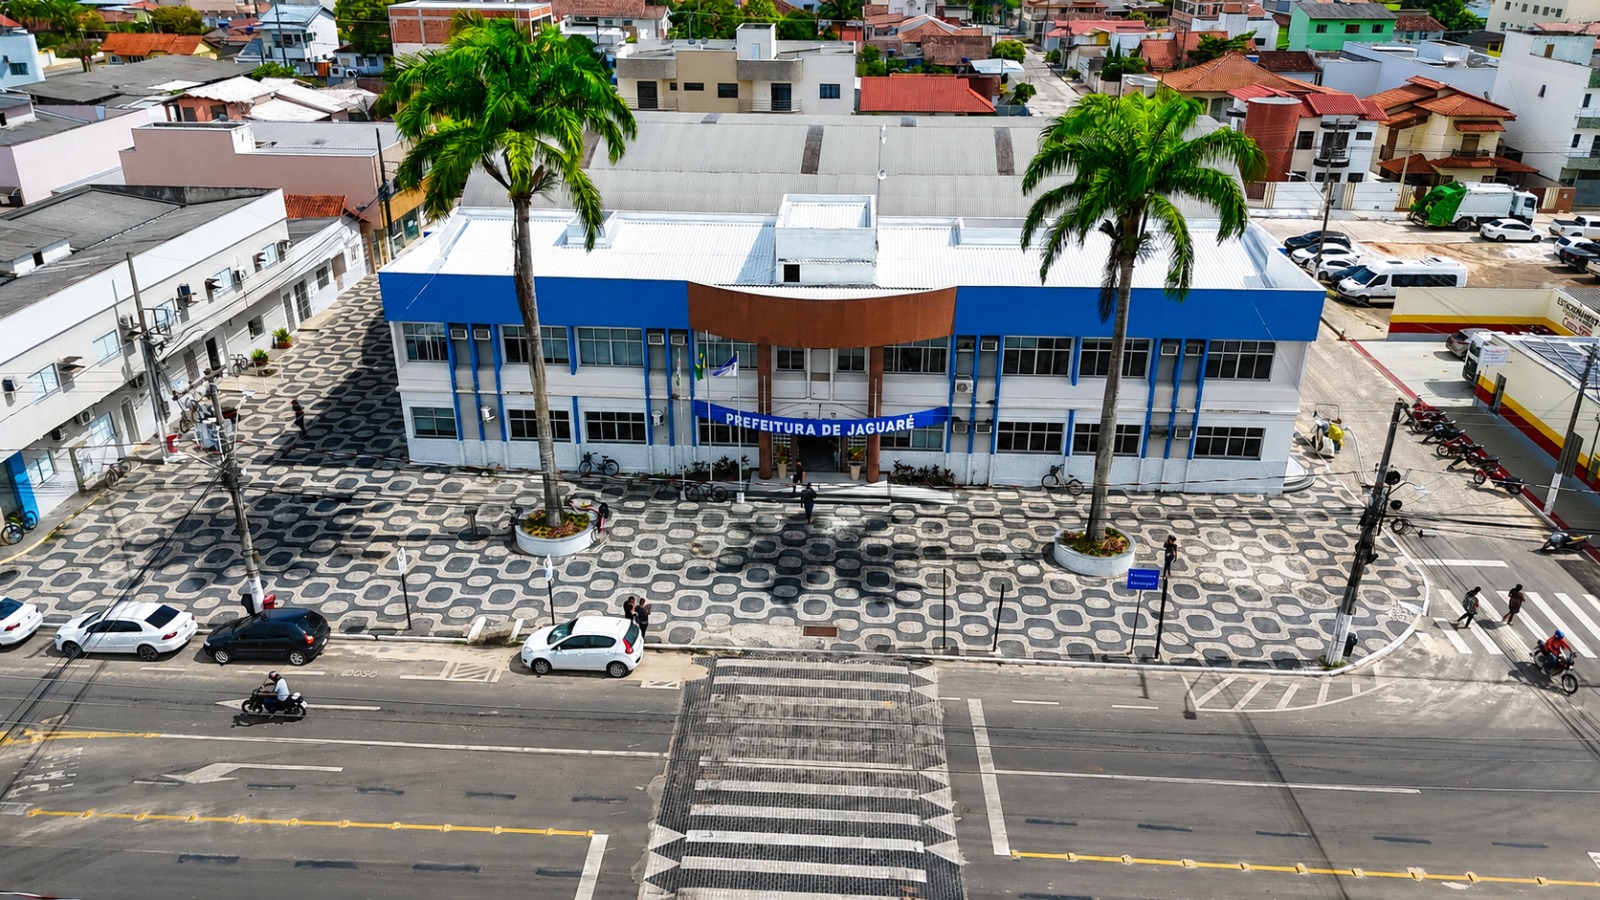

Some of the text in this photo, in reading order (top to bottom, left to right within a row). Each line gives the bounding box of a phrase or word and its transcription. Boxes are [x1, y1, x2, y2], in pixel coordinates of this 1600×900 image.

[726, 412, 915, 436] PREFEITURA DE JAGUARÉ
